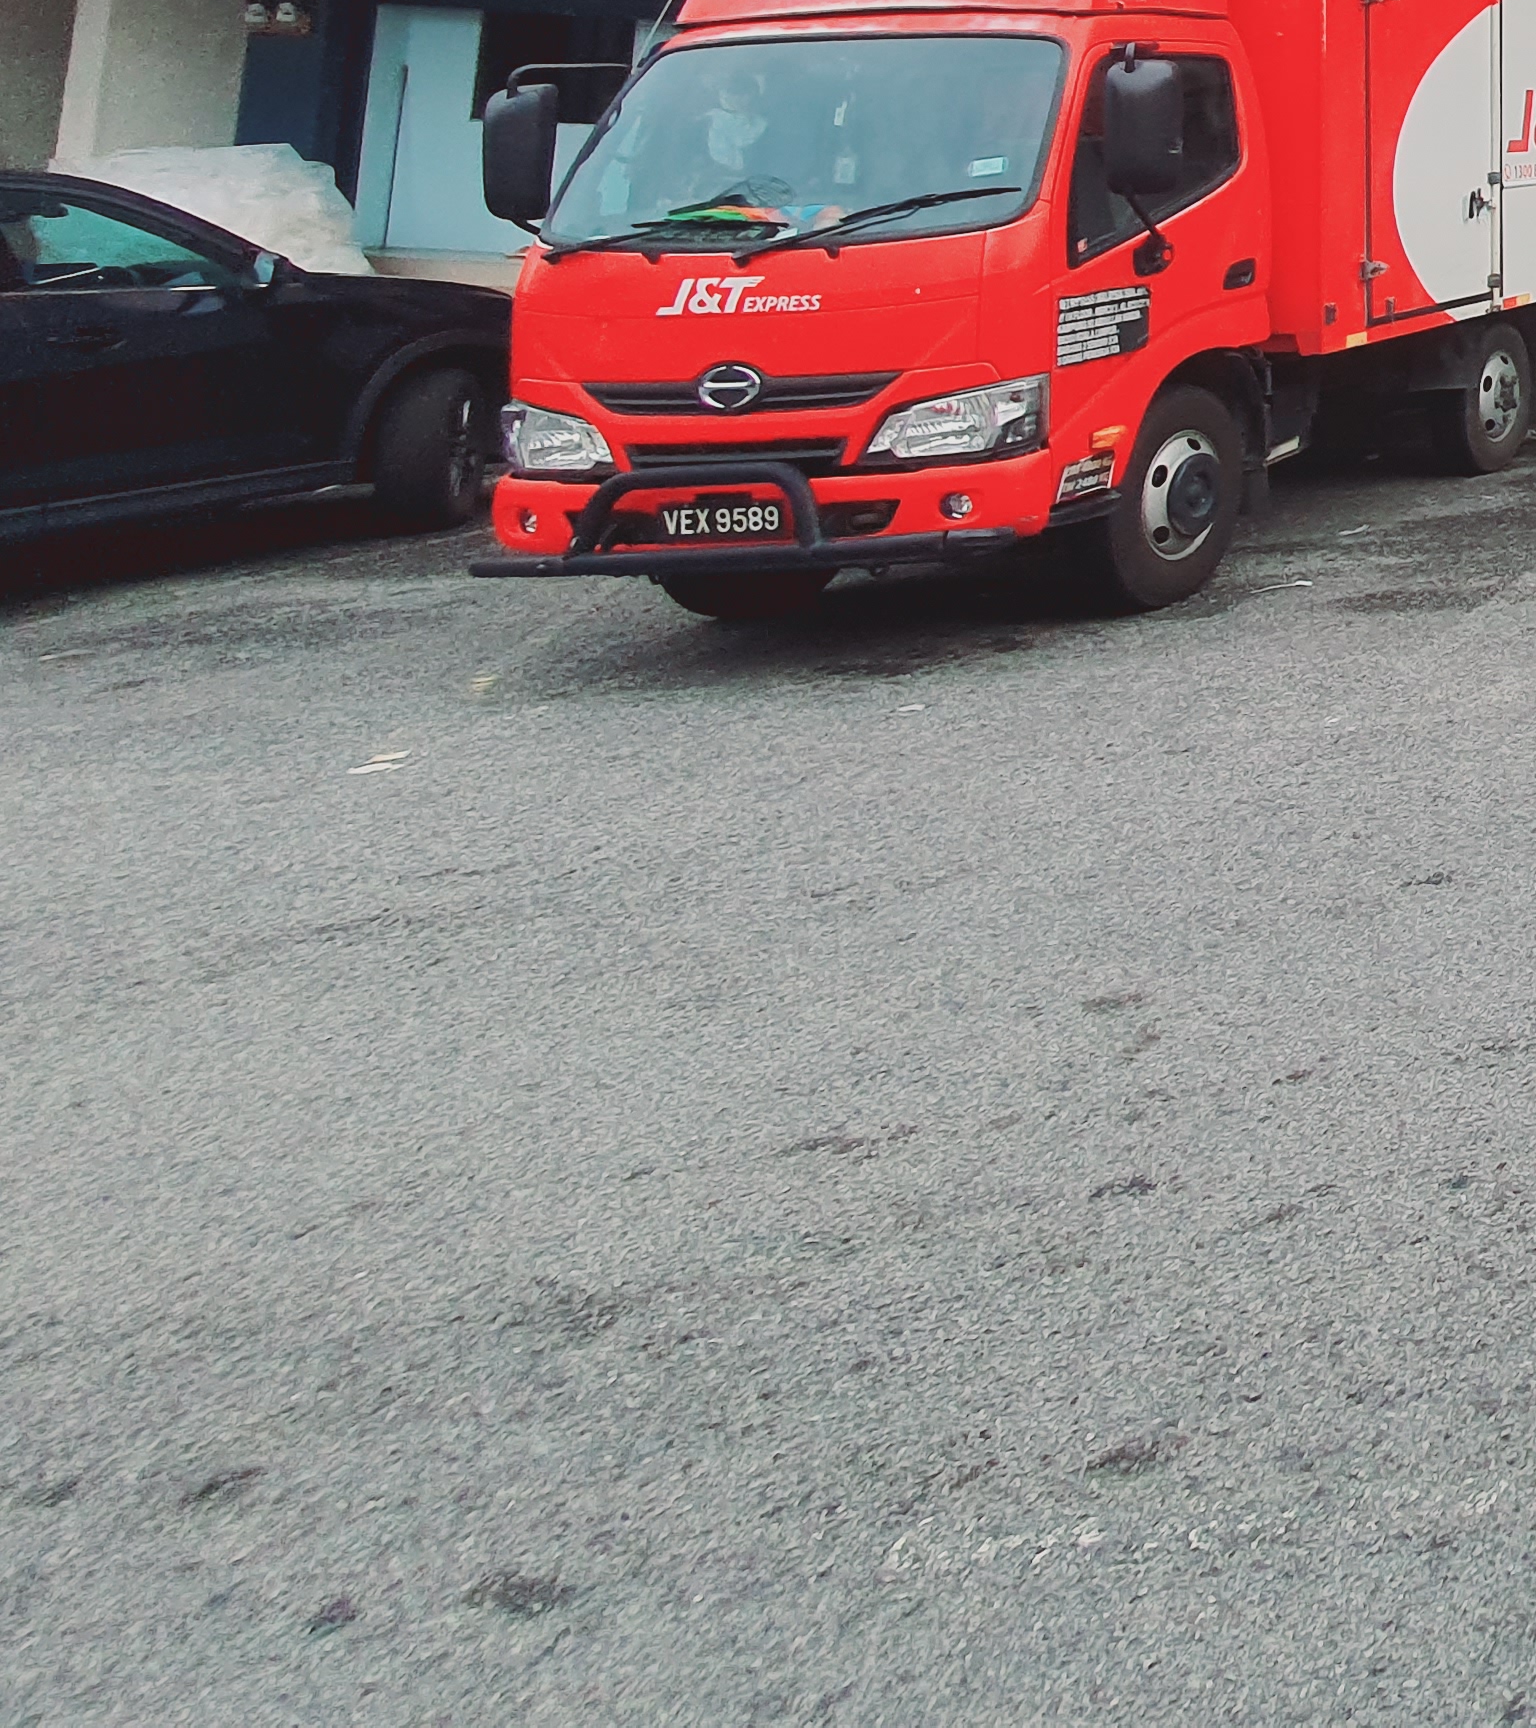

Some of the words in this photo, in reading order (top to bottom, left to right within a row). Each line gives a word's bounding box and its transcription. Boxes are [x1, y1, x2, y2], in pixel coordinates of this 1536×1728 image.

[655, 275, 766, 317] J&T
[743, 294, 823, 314] EXPRESS
[662, 508, 711, 535] VEX
[715, 505, 779, 533] 9589
